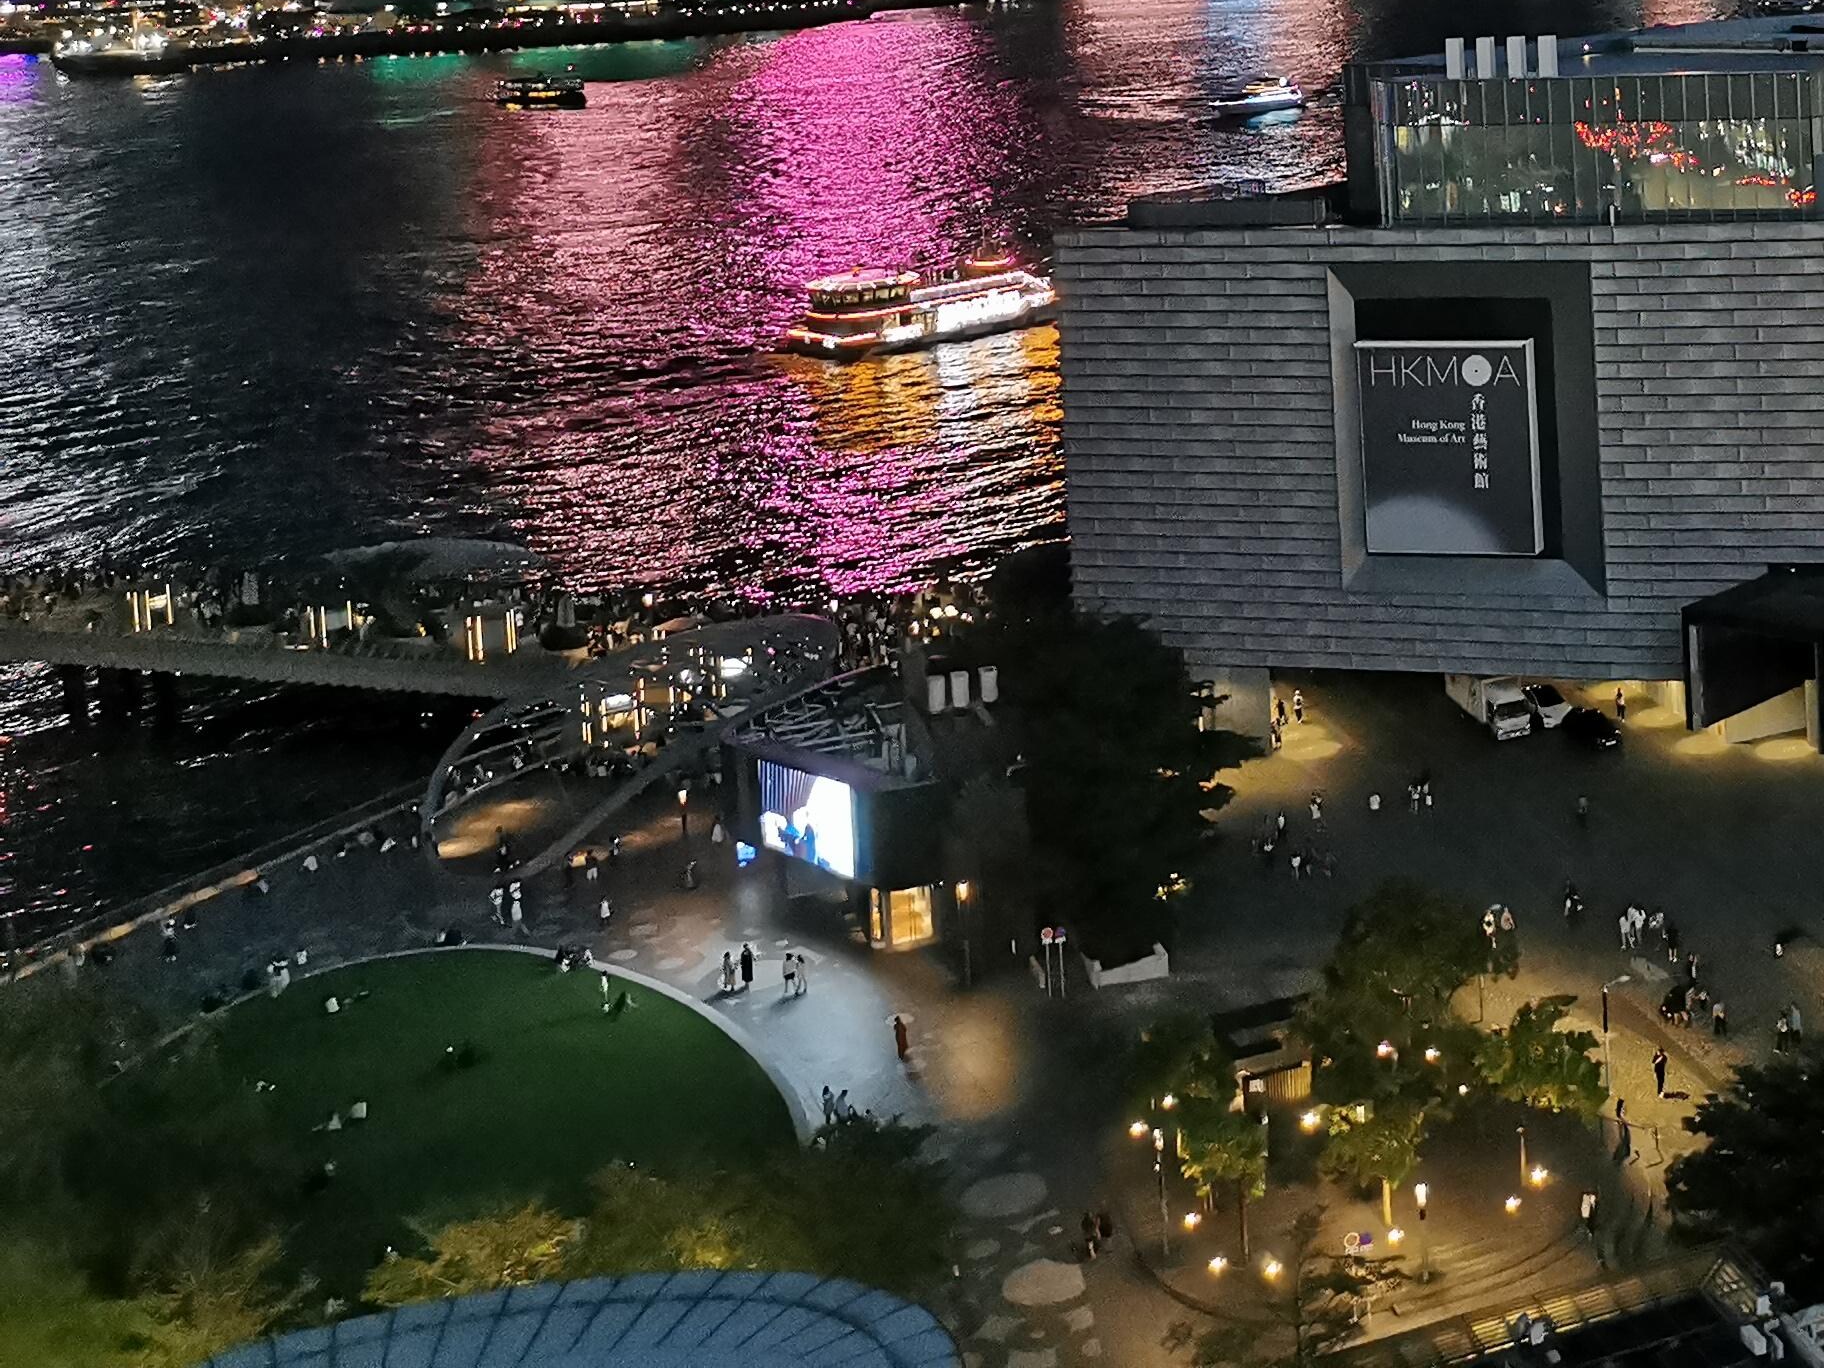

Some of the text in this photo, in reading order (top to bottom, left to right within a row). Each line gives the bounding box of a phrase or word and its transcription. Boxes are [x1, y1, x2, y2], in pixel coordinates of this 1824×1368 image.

[1370, 354, 1521, 387] HKMOA
[1411, 420, 1466, 432] Hong Kong
[1398, 433, 1437, 443] Museum
[1439, 433, 1450, 443] of
